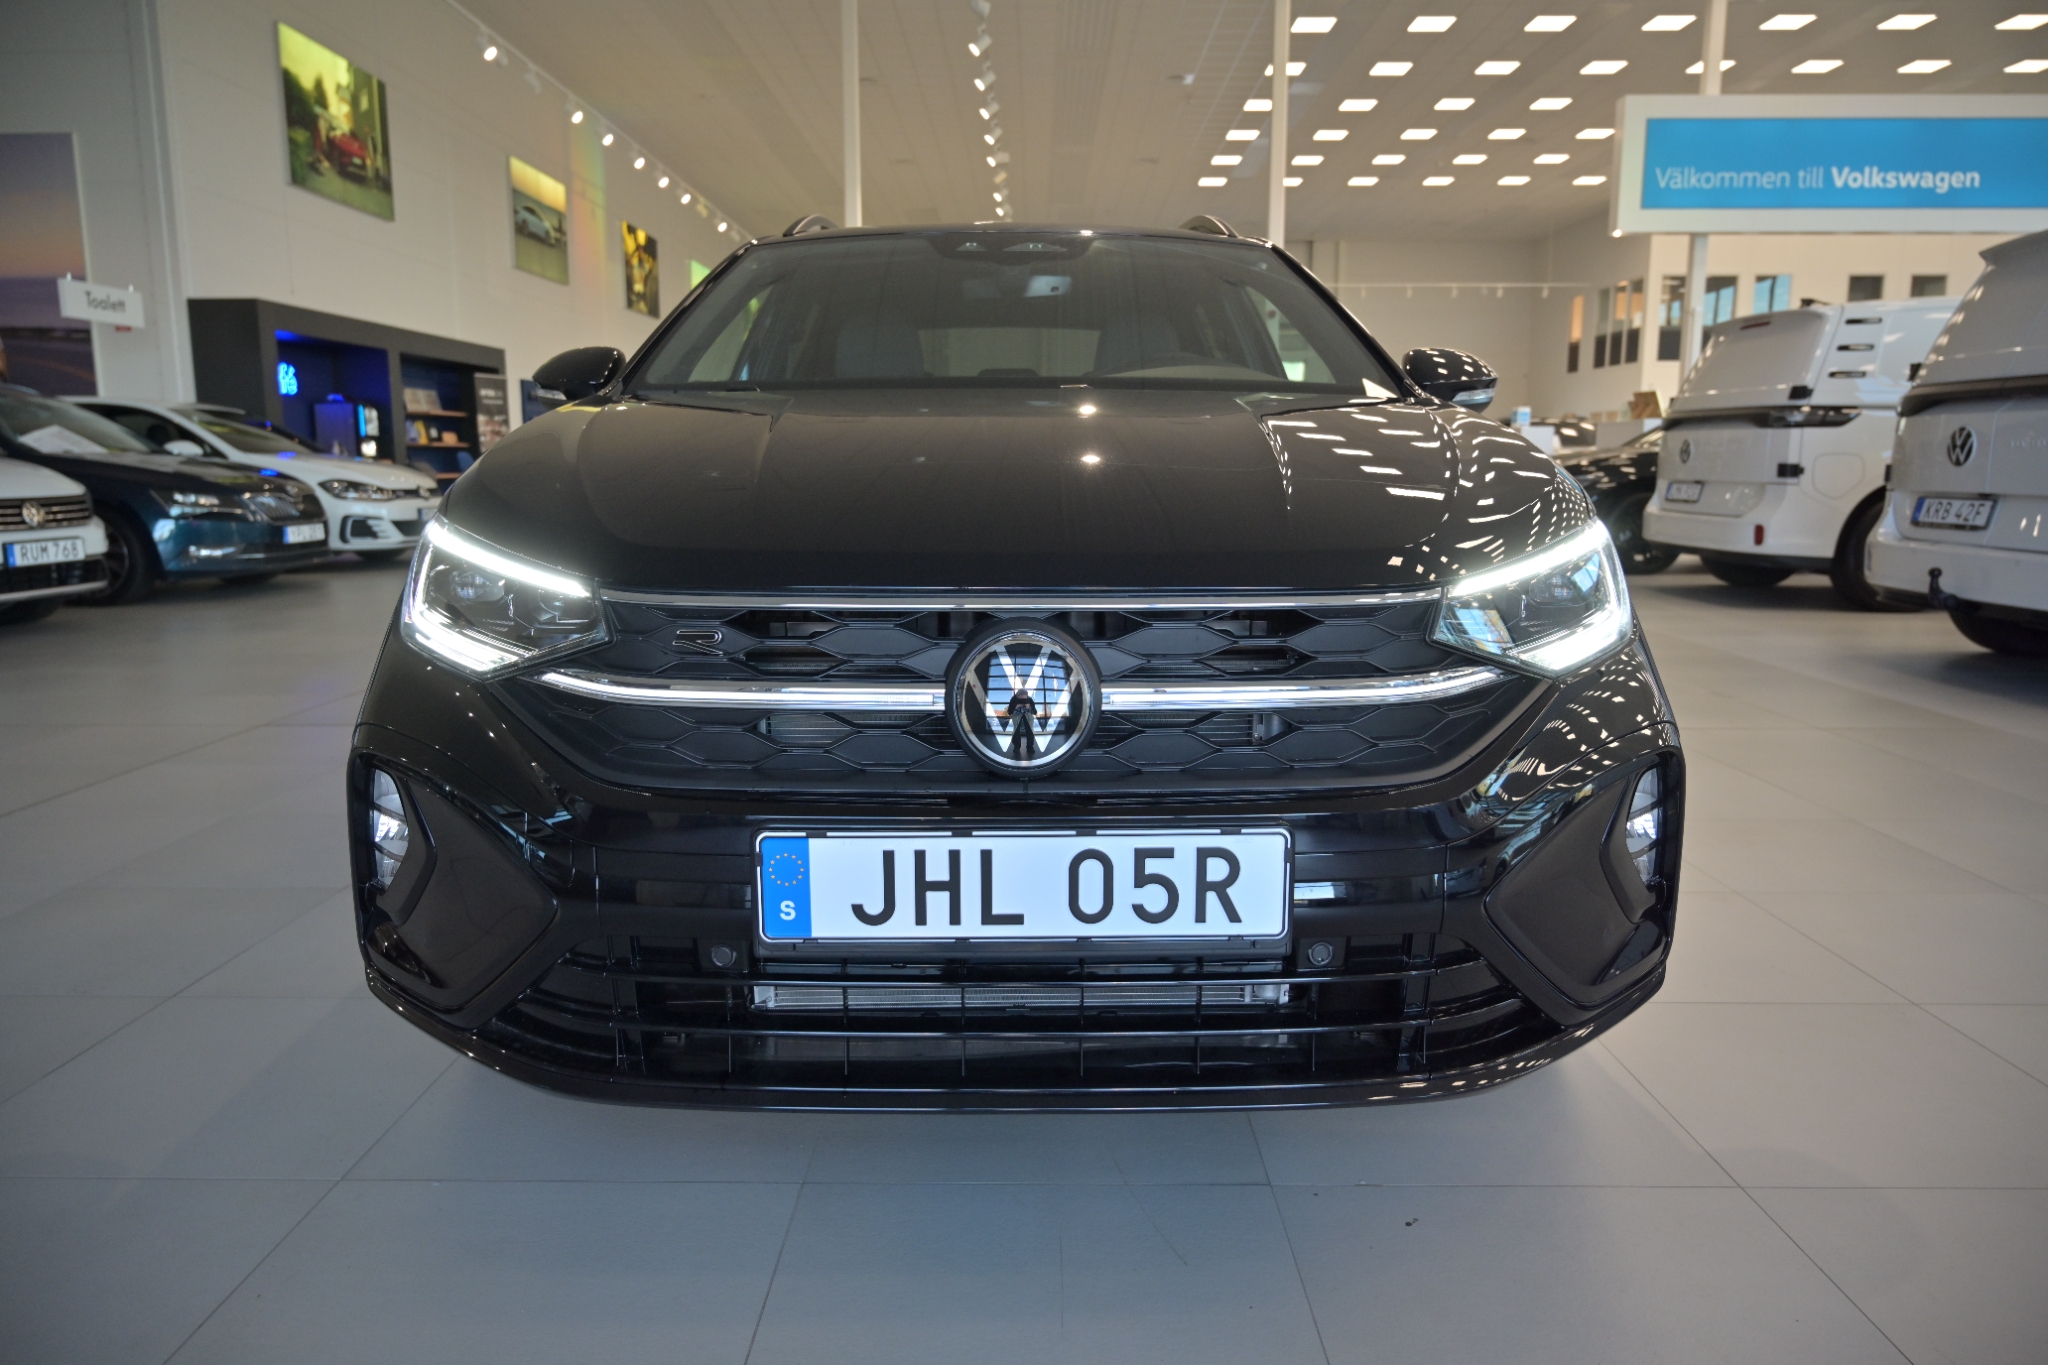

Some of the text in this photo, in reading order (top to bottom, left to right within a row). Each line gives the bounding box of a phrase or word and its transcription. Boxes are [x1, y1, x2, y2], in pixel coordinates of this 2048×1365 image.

[1655, 165, 1981, 194] Välkommen till Volkswagen
[84, 290, 127, 313] Toalett
[1923, 501, 1986, 522] KRB 42F
[20, 541, 80, 563] RUM 768
[962, 638, 1087, 754] VW
[850, 846, 1243, 927] JHL 05R
[779, 900, 797, 921] S
